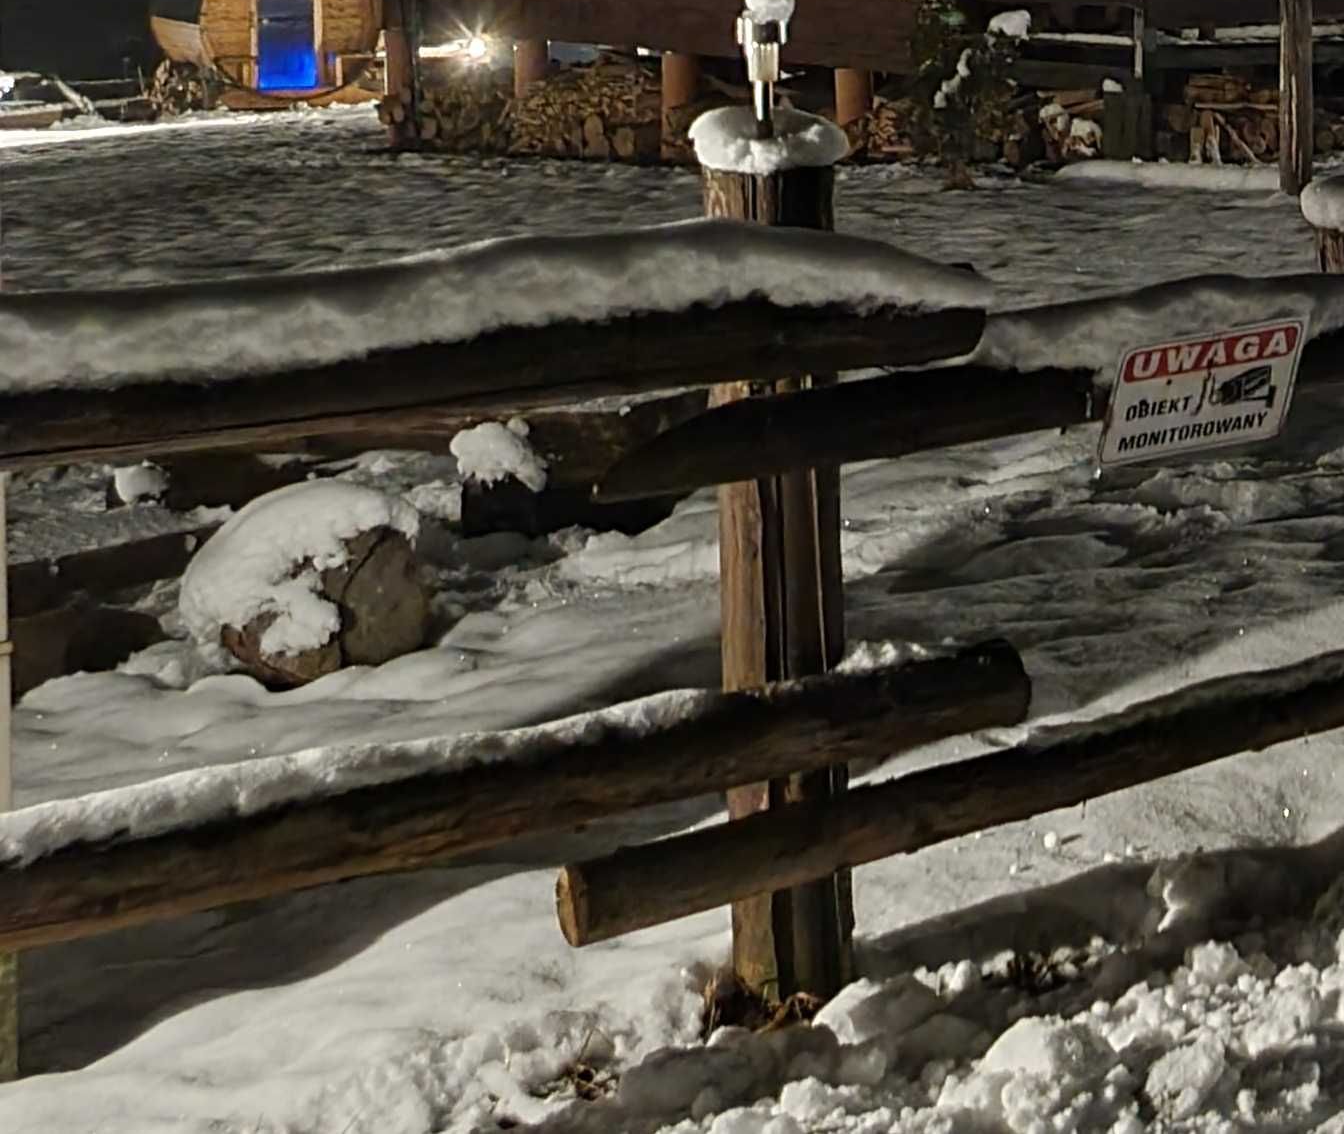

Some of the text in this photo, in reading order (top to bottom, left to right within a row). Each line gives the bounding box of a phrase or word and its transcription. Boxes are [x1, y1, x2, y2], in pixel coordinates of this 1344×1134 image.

[1133, 329, 1289, 378] UWAGA
[1126, 395, 1194, 422] OBIEKT
[1117, 411, 1268, 453] MONITOROWANY
